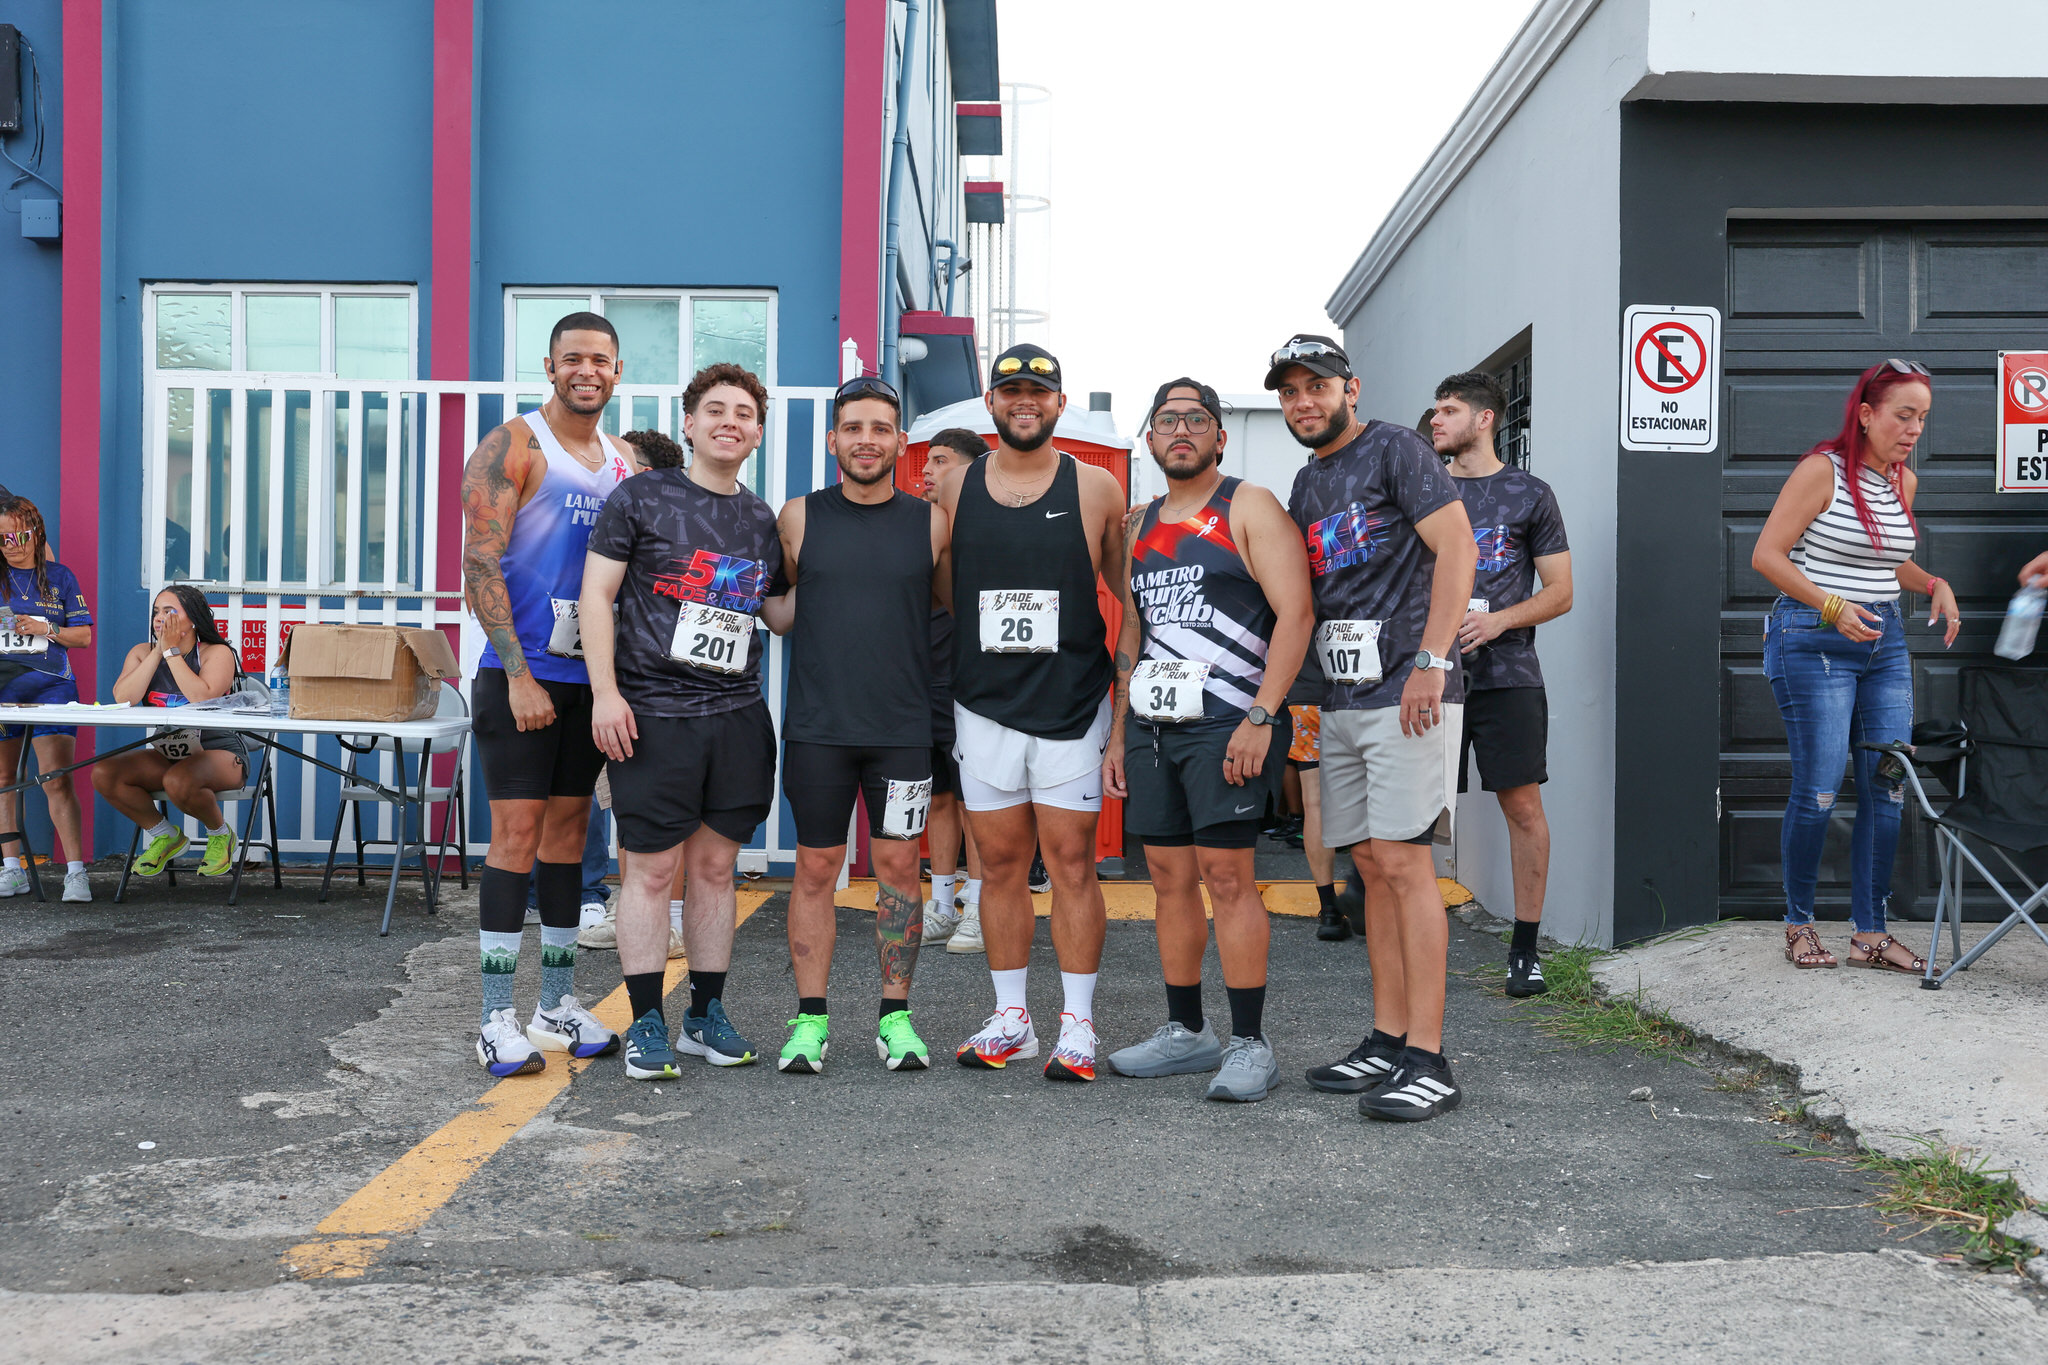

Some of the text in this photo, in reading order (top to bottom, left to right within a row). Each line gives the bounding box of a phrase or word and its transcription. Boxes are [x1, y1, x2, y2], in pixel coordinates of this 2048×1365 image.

[1661, 401, 1679, 413] NO
[1632, 417, 1707, 430] ESTACIONAR
[565, 493, 582, 508] LA
[1308, 511, 1346, 562] 5K
[679, 549, 756, 595] 5K
[1325, 559, 1333, 573] &
[1130, 565, 1204, 593] LA METRO
[652, 581, 707, 603] FADE
[706, 592, 719, 606] &
[1005, 593, 1033, 602] FADE
[1140, 584, 1180, 608] run
[1018, 603, 1043, 611] RUN
[711, 611, 739, 625] FADE
[723, 624, 741, 633] RUN
[1000, 618, 1033, 642] 26
[1332, 623, 1354, 632] FADE
[2, 632, 35, 648] 137
[1342, 633, 1363, 641] RUN
[690, 633, 736, 663] 201
[1160, 662, 1183, 671] FADE
[1327, 649, 1361, 674] 107
[1150, 686, 1177, 711] 34
[160, 743, 191, 757] 152
